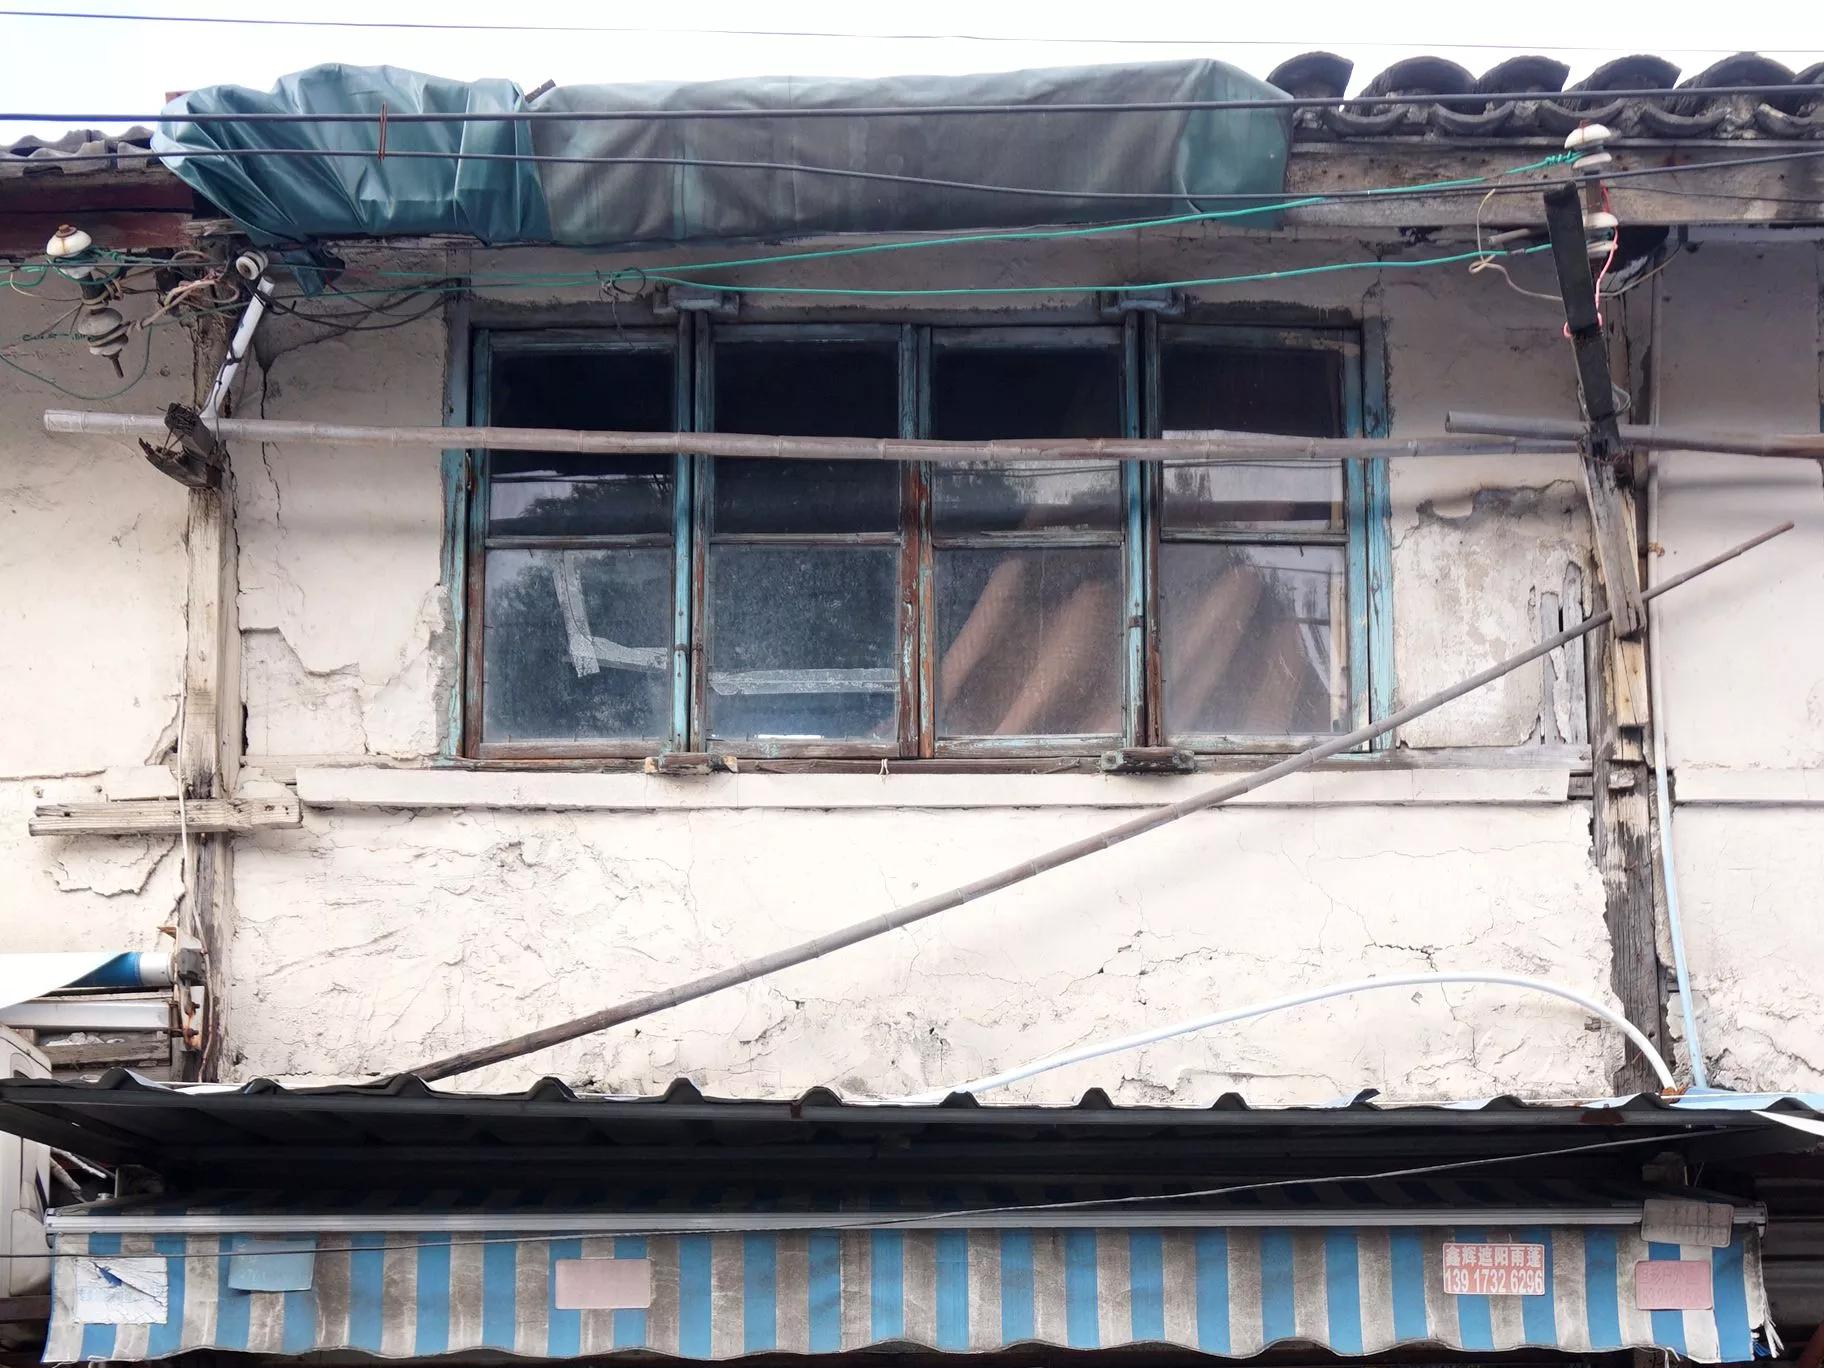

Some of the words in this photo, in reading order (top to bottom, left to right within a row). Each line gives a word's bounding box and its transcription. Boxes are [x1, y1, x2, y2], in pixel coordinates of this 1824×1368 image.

[1445, 1269, 1469, 1292] 139
[1474, 1269, 1507, 1293] 1732
[1511, 1270, 1543, 1293] 6296
